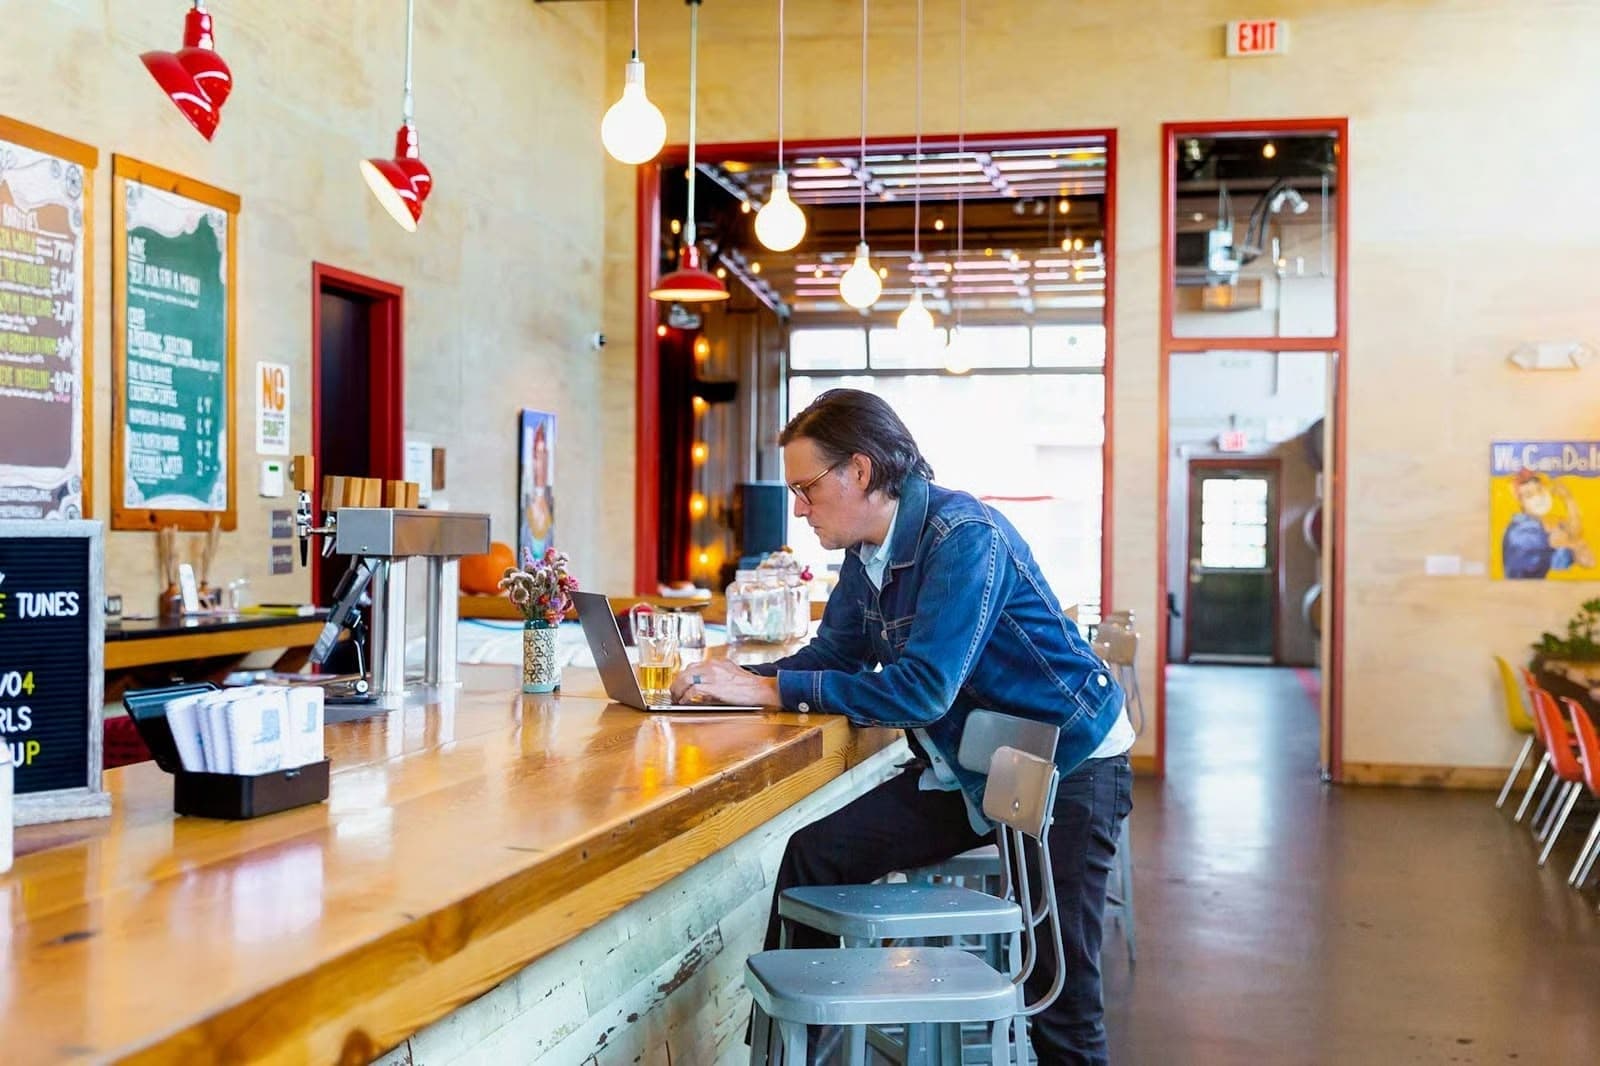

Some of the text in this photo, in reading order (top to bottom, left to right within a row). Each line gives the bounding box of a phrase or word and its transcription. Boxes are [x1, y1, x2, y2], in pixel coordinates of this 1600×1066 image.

[1239, 22, 1276, 51] EXIT
[1494, 444, 1520, 472] We
[1521, 444, 1562, 472] Can
[1563, 445, 1588, 472] Do
[15, 591, 80, 619] TUNES
